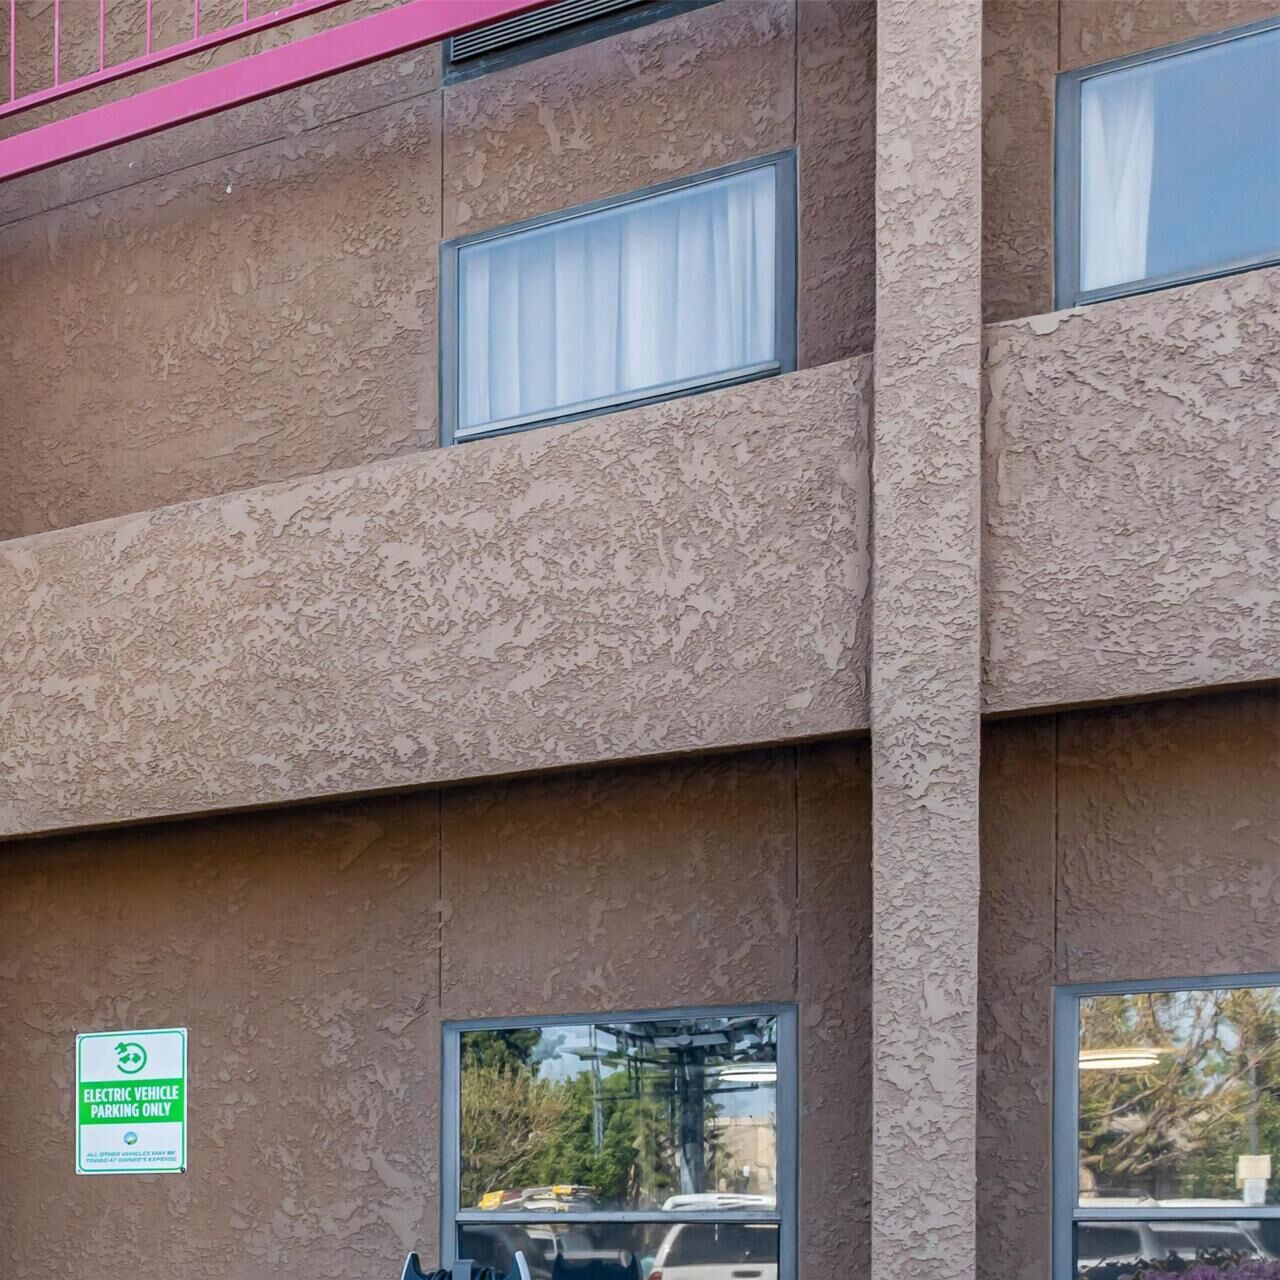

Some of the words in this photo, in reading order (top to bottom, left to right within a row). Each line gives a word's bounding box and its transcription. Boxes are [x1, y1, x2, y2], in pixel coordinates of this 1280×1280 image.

[84, 1087, 131, 1103] ELECTRIC
[134, 1085, 180, 1100] VEHICLE
[90, 1102, 139, 1119] PARKING
[142, 1101, 173, 1117] ONLY
